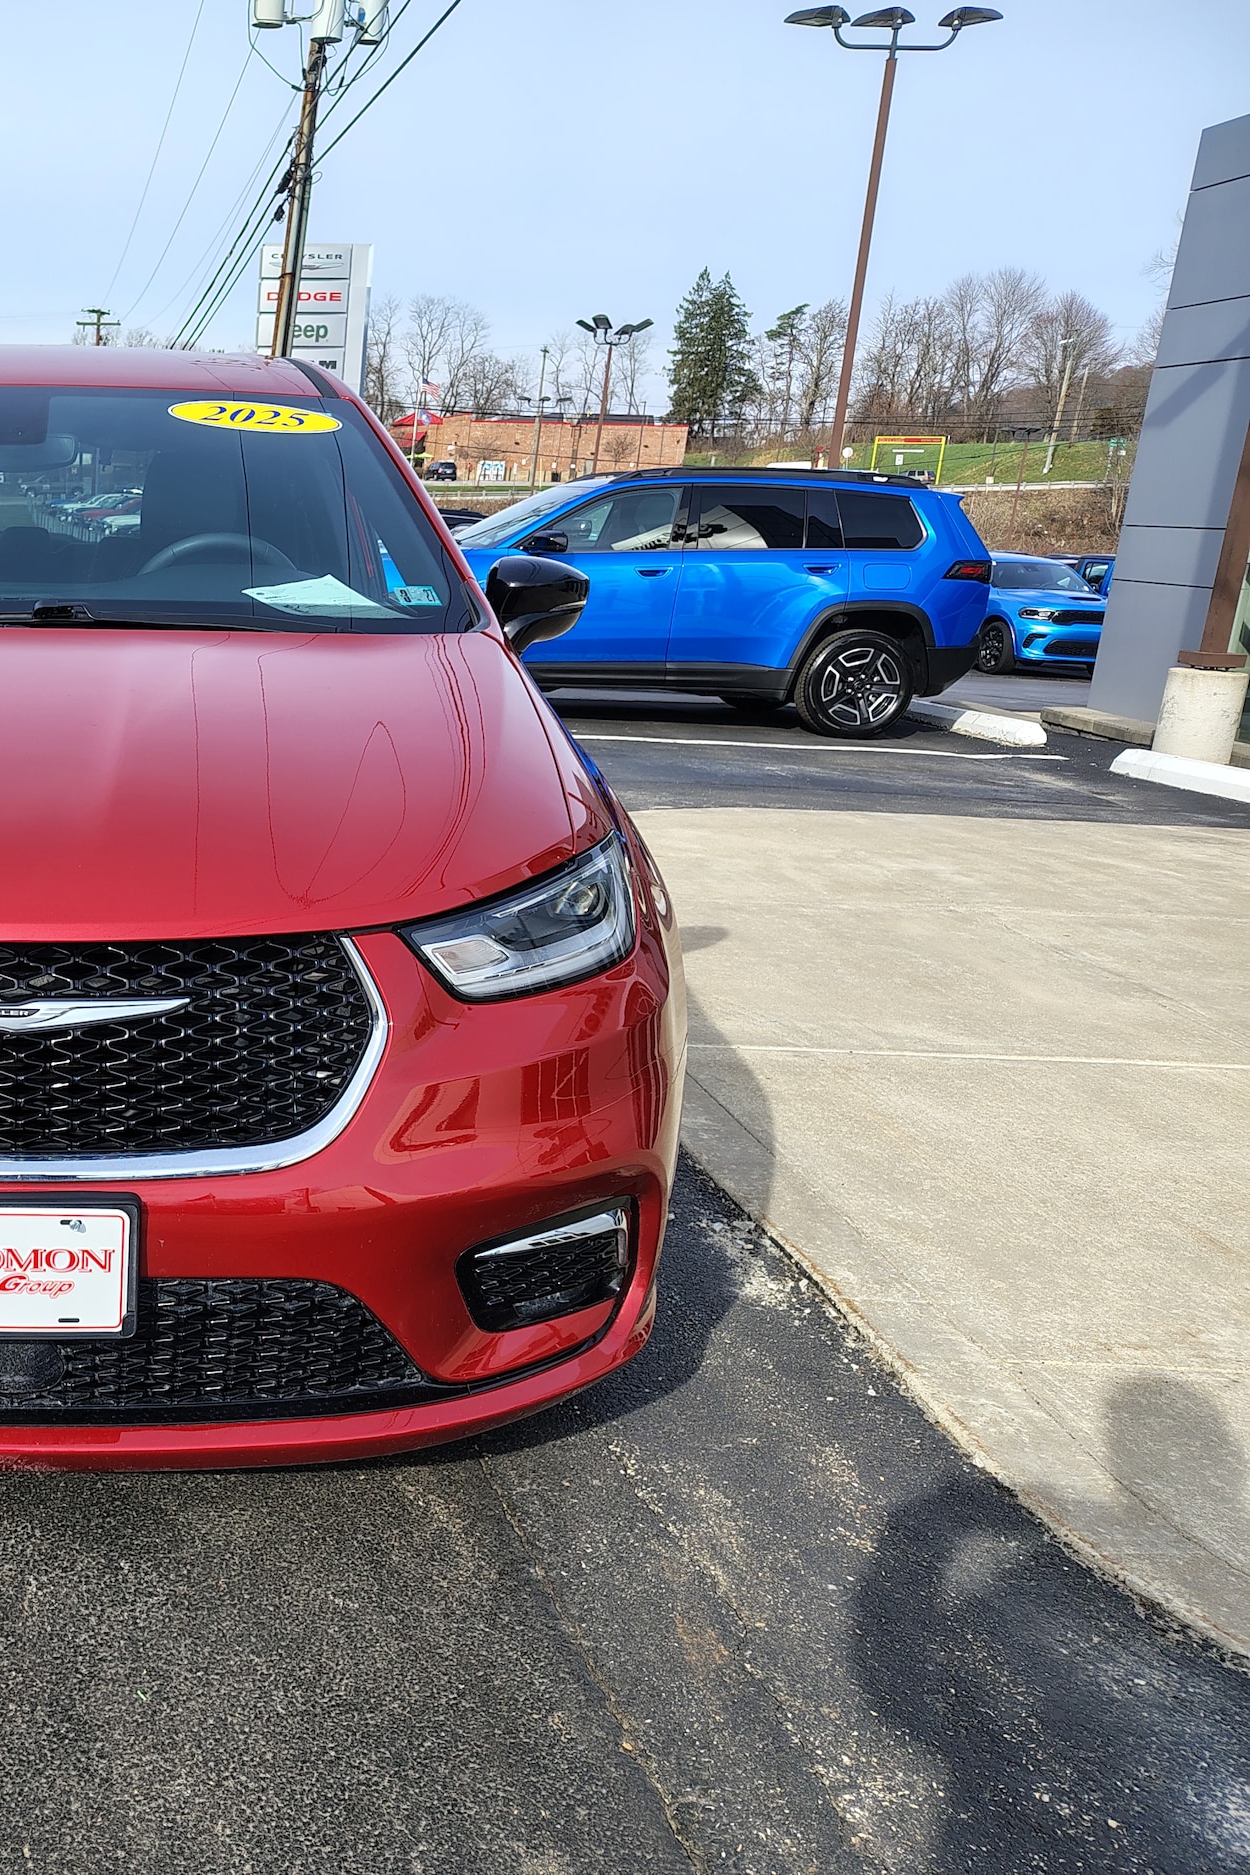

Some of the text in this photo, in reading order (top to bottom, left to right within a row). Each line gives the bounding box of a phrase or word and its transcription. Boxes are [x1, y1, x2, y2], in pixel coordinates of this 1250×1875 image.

[267, 292, 342, 301] DDGE
[293, 324, 328, 342] eep
[199, 405, 310, 427] 2025
